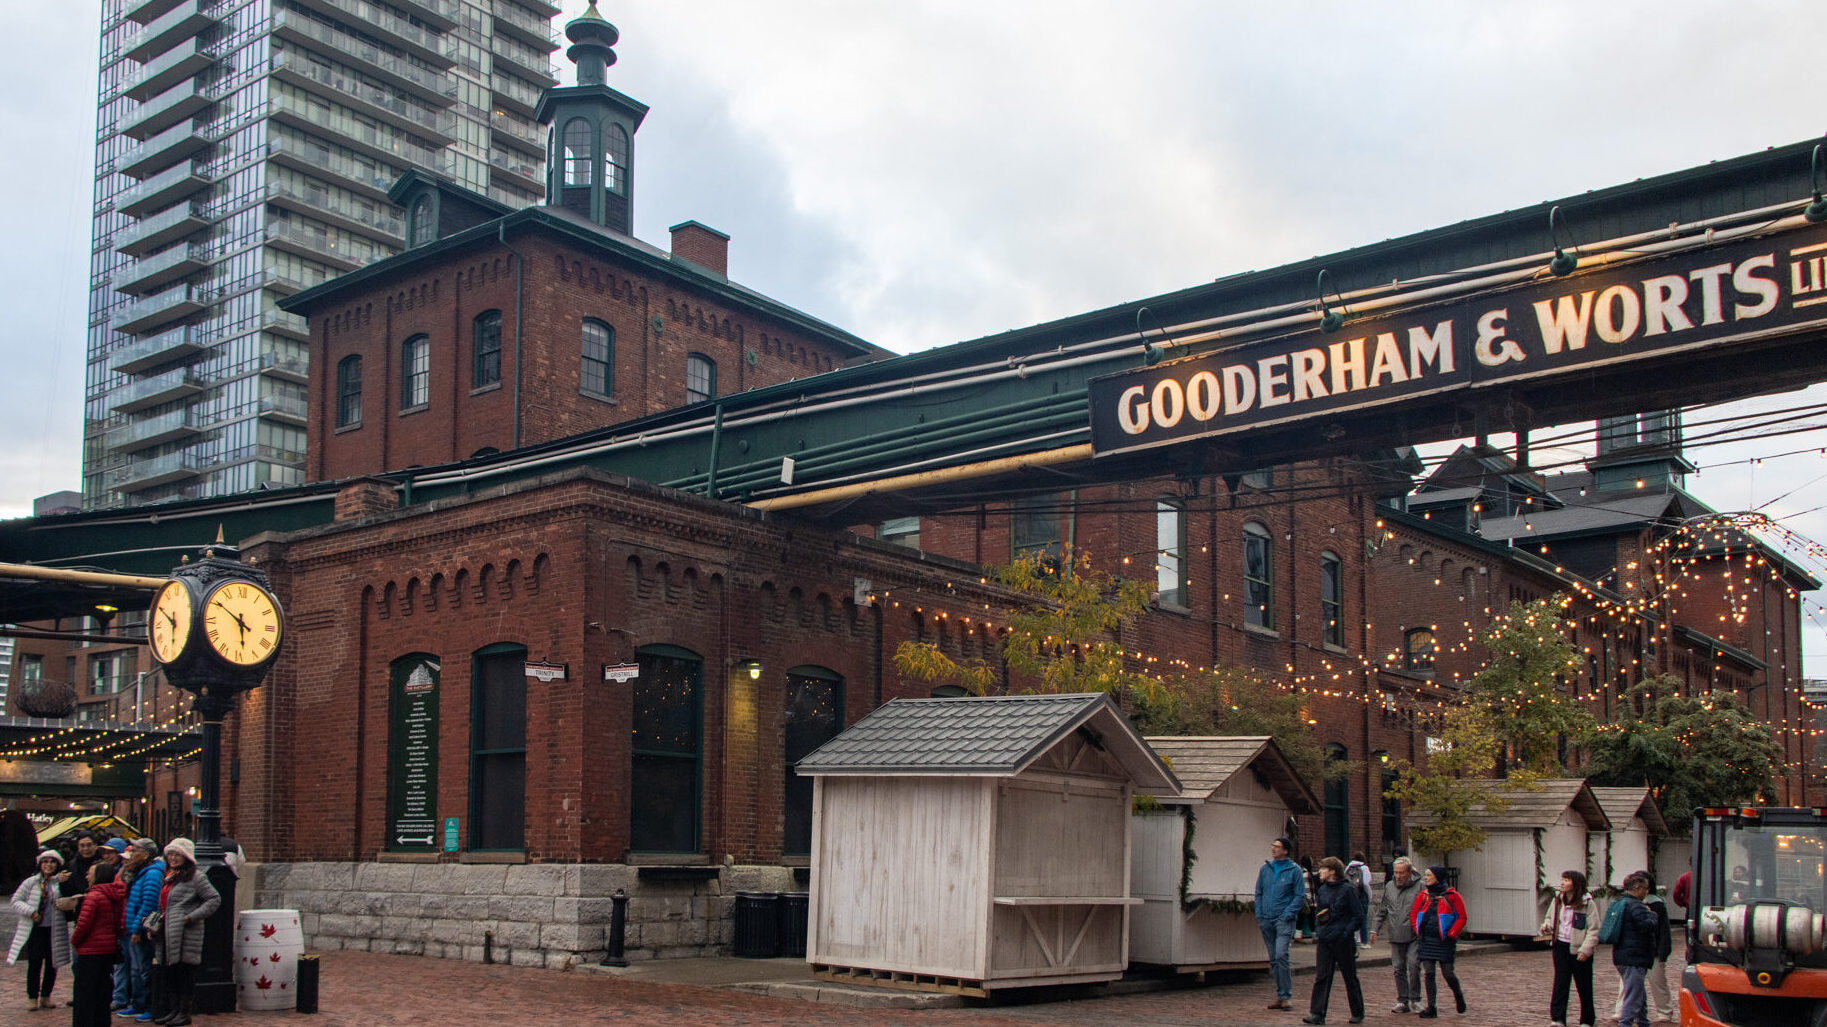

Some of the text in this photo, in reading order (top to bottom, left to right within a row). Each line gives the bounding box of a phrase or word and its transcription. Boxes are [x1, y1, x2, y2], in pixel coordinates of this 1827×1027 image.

[1117, 252, 1780, 435] GOODERHAM & WORTS
[265, 625, 276, 633] III
[535, 669, 555, 677] TRINITY
[26, 812, 54, 825] Hatley
